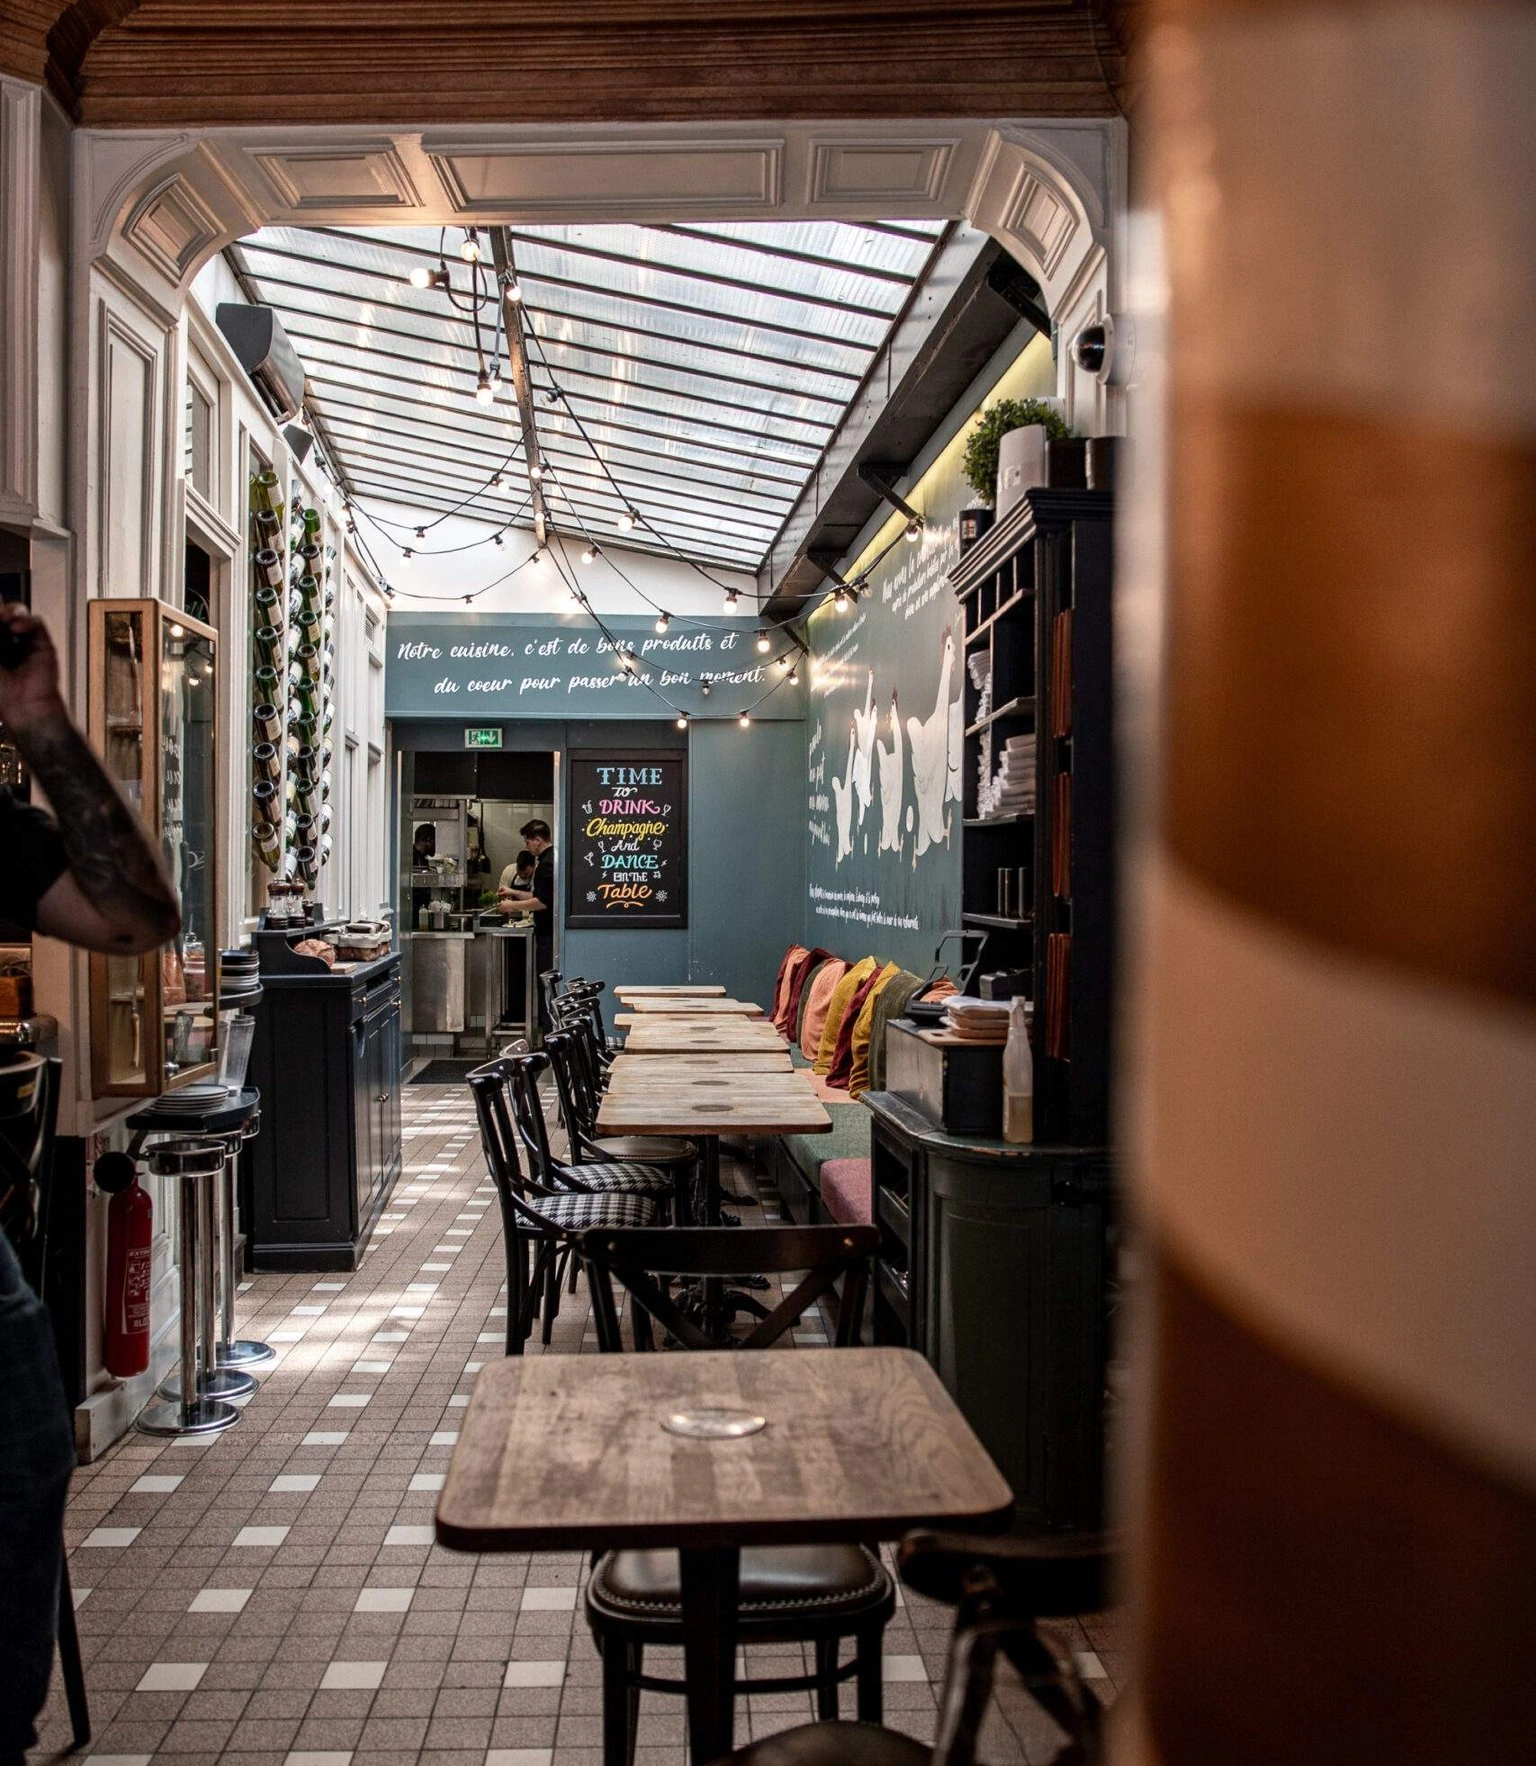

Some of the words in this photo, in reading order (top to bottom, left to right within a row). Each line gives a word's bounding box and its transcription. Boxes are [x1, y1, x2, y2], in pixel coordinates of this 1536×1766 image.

[397, 641, 443, 660] Notre
[524, 637, 564, 656] c'est
[567, 638, 591, 654] de
[596, 637, 636, 653] bons
[641, 632, 713, 656] produits
[720, 632, 739, 650] et
[434, 677, 460, 694] du
[467, 678, 513, 693] coeur
[519, 677, 561, 695] pour
[567, 675, 619, 693] passer
[627, 673, 654, 687] un
[660, 670, 691, 686] bon
[596, 767, 663, 785] TIME
[599, 799, 661, 815] DRINK
[586, 817, 666, 841] Champagne
[610, 838, 641, 852] And
[600, 854, 659, 870] DANCE
[597, 883, 653, 899] Table
